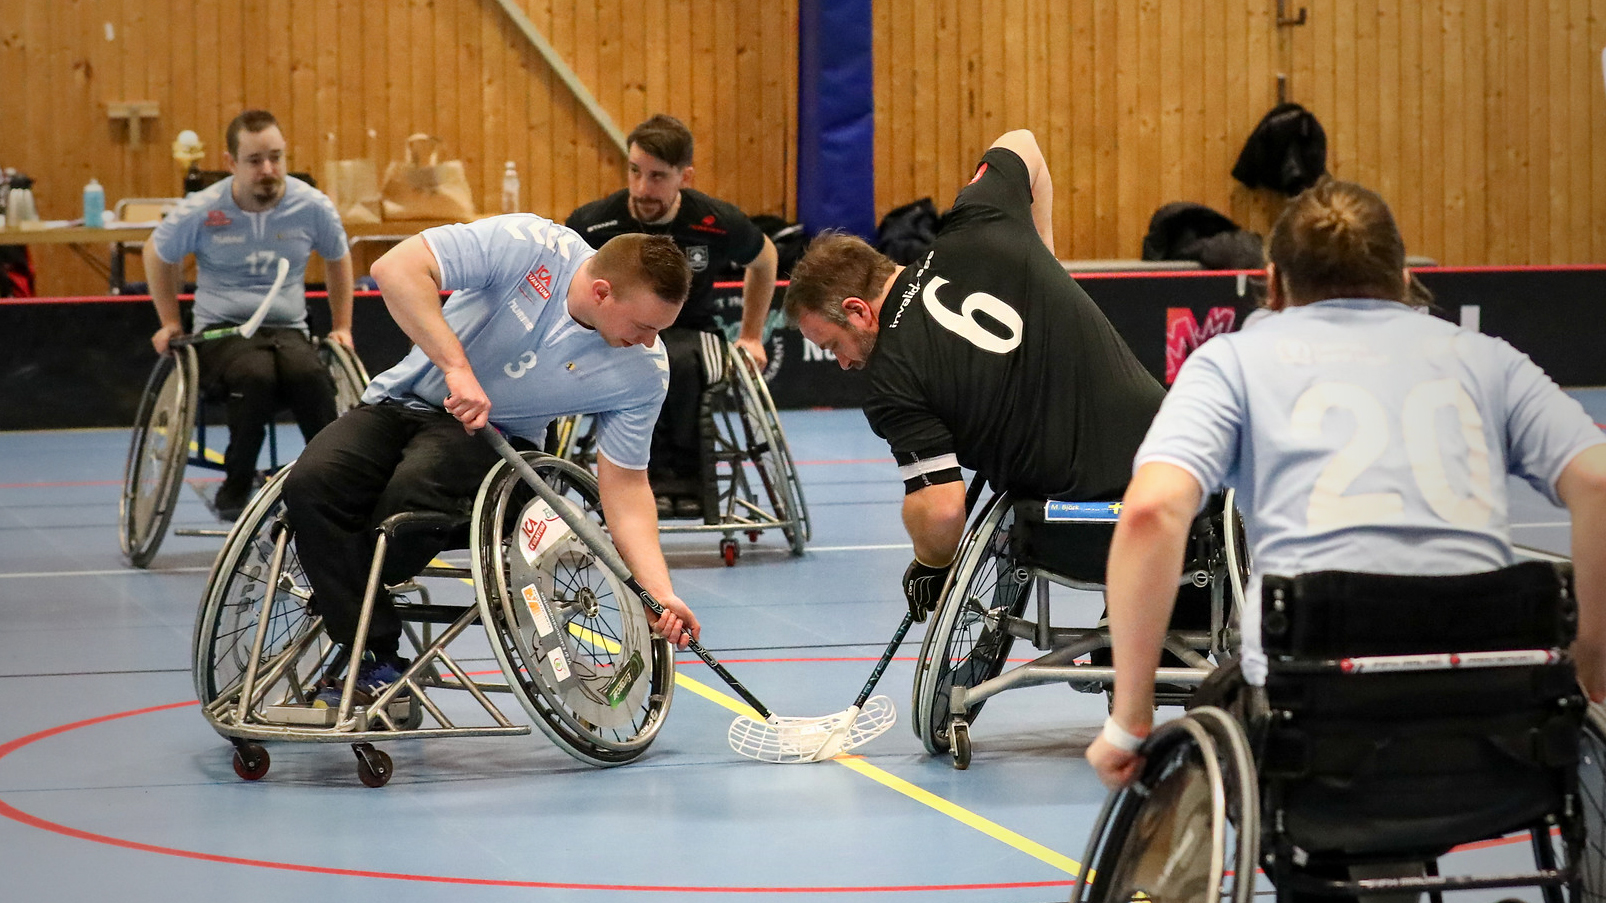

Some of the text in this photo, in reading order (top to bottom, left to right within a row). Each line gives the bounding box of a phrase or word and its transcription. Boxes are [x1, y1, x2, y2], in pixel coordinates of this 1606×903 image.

[245, 251, 276, 274] 17
[535, 264, 552, 287] ICA
[922, 275, 1024, 354] 6
[503, 350, 537, 379] 3
[1291, 378, 1491, 529] 20
[522, 518, 538, 538] ICA
